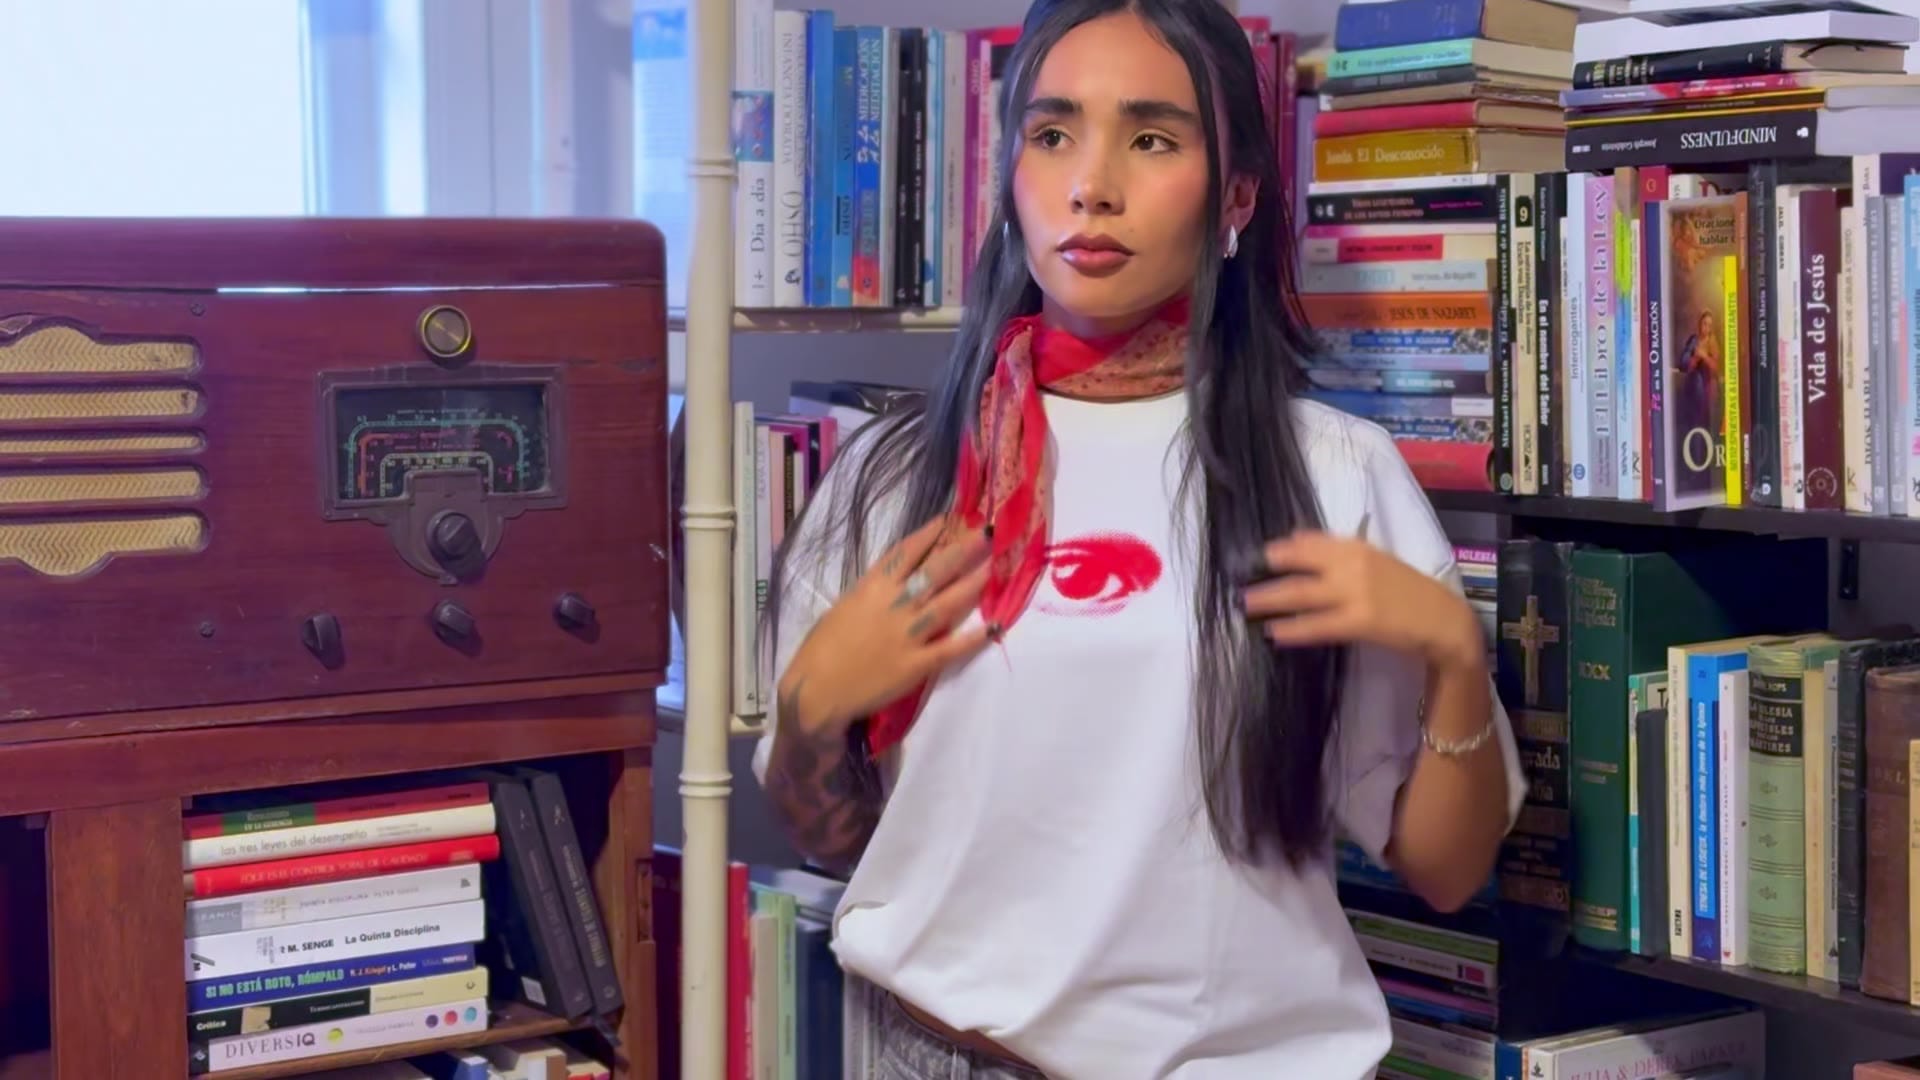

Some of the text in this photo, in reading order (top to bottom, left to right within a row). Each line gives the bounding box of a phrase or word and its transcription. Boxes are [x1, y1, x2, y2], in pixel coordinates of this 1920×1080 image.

[1634, 137, 1657, 149] Joseph
[1680, 126, 1777, 149] MINDFULNESS
[1357, 147, 1369, 162] El
[1375, 144, 1445, 163] Desconocido
[754, 208, 765, 217] a
[1499, 188, 1507, 220] Biblia
[1592, 184, 1608, 239] Ley
[781, 191, 804, 258] OSHO
[1699, 234, 1728, 246] hablar
[1592, 246, 1608, 272] la
[1592, 279, 1608, 318] de
[1569, 297, 1580, 380] Interrogantes
[1805, 254, 1831, 404] Vida de Jesús
[1540, 299, 1552, 426] En el nombre del Señor
[1593, 324, 1609, 400] Libro
[1501, 406, 1509, 448] Michael
[1593, 407, 1609, 434] El
[1864, 424, 1873, 465] DIOS
[221, 845, 237, 857] las
[239, 842, 258, 854] tres
[261, 838, 287, 853] leyes
[290, 834, 306, 848] del
[310, 830, 368, 848] desempeño
[337, 858, 366, 873] TOTAL
[287, 923, 441, 954] M. SENGE La Quinta Disciplina
[205, 968, 345, 999] SI NO ESTÁ ROTO, RÓMPALO
[225, 1032, 316, 1059] DIVERSIQ
